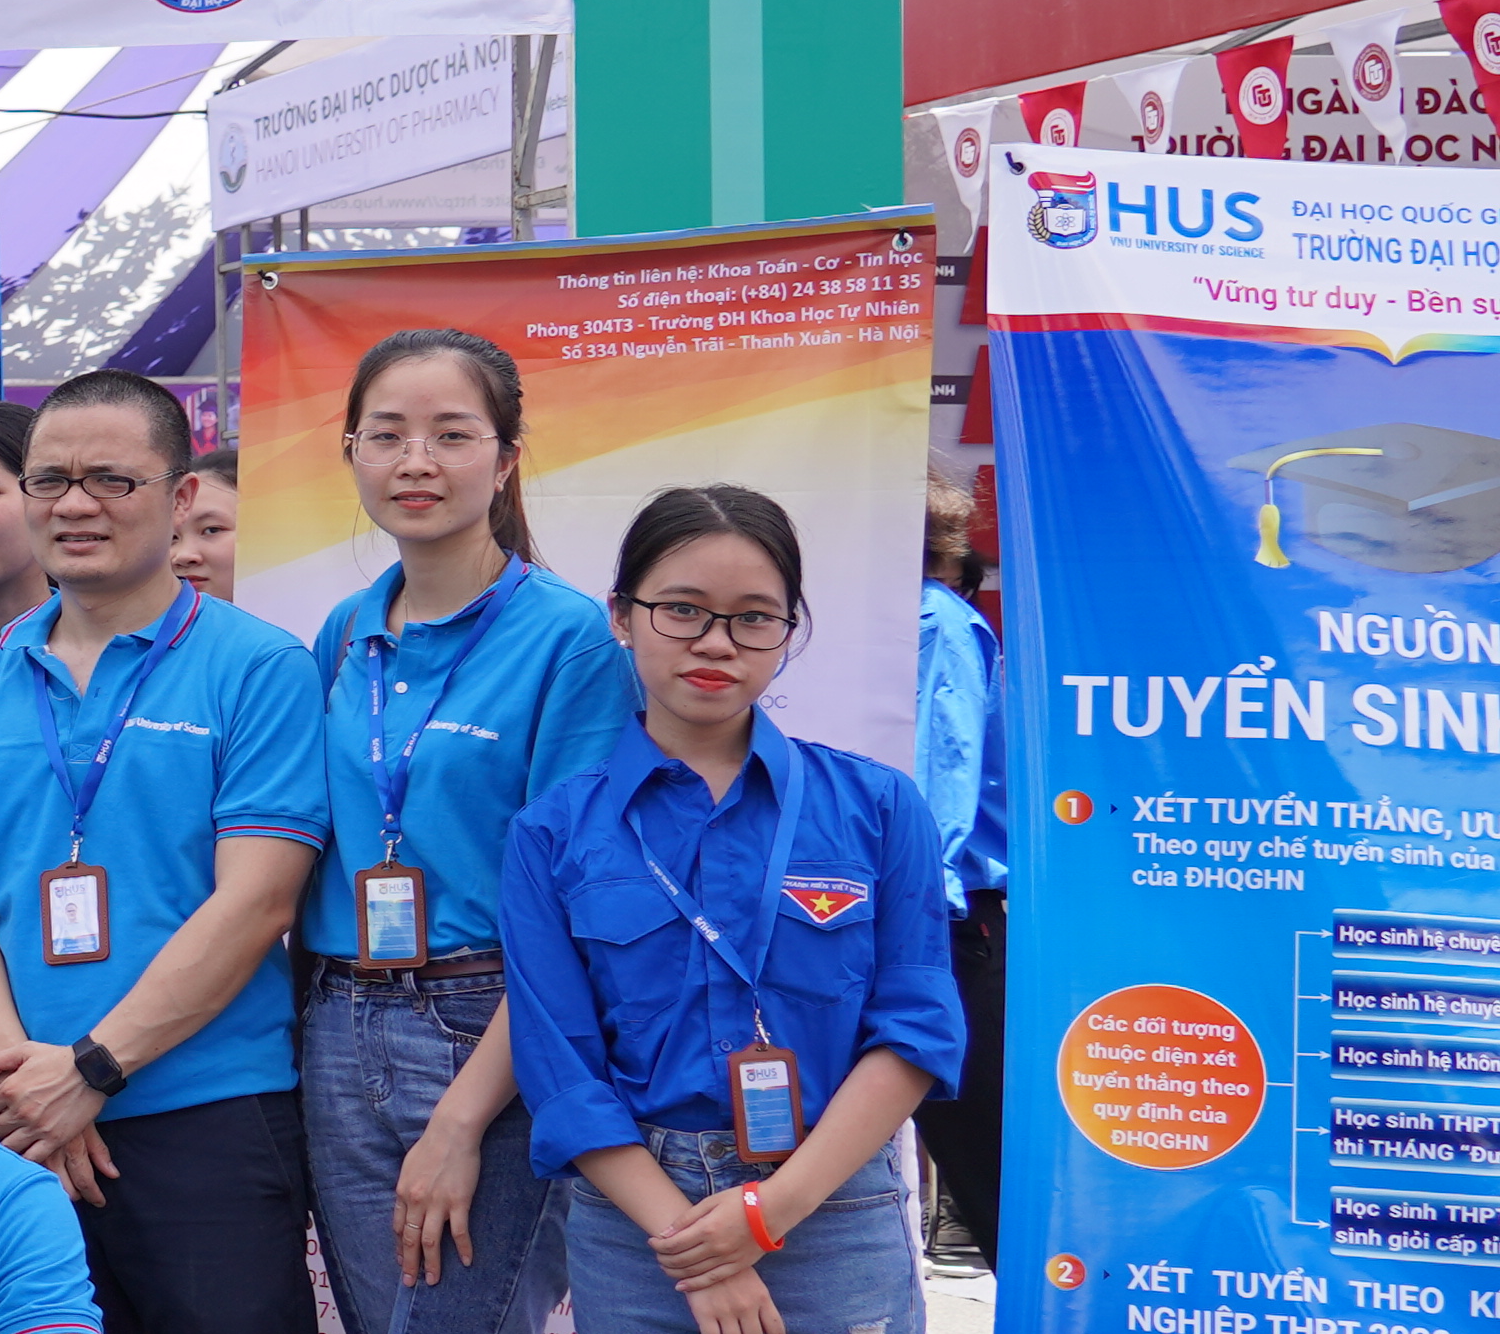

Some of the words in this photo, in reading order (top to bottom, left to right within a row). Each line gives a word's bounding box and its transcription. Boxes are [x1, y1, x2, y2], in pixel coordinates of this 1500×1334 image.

[254, 100, 317, 141] TRƯỜNG
[321, 93, 347, 122] ĐẠI
[352, 81, 385, 113] HỌC
[389, 64, 440, 97] DƯỢC
[444, 43, 470, 80] HÀ
[255, 147, 299, 184] HANOI
[302, 124, 384, 169] UNIVERSITY
[387, 114, 408, 144] OF
[411, 84, 501, 134] PHARMACY
[1107, 181, 1265, 241] HUS
[557, 274, 609, 290] Thông
[612, 271, 635, 286] tin
[640, 267, 668, 284] liên
[676, 266, 702, 284] hệ:
[707, 261, 751, 279] Khoa
[756, 258, 798, 276] Toán
[813, 255, 838, 272] Cơ
[856, 251, 883, 268] Tin
[888, 249, 923, 270] học
[617, 291, 640, 309] Số
[643, 291, 681, 309] điện
[685, 285, 736, 305] thoại:
[741, 283, 787, 304] (+84)
[792, 282, 815, 298] 24
[819, 279, 842, 297] 38
[845, 277, 867, 294] 58
[871, 275, 892, 292] 11
[898, 273, 921, 290] 35
[526, 322, 578, 340] Phòng
[583, 318, 633, 336] 304T3
[648, 312, 714, 333] Trường
[718, 309, 745, 326] ĐH
[750, 307, 795, 325] Khoa
[801, 305, 834, 324] Học
[838, 301, 861, 322] Tự
[866, 299, 920, 318] Nhiên
[562, 340, 582, 359] Số
[586, 341, 617, 359] 334
[623, 334, 687, 359] Nguyễn
[694, 336, 724, 352] Trãi
[739, 331, 794, 350] Thanh
[799, 328, 841, 346] Xuân
[859, 324, 883, 342] Hà
[889, 323, 920, 342] Nội
[1319, 605, 1500, 664] NGUỒN
[1063, 655, 1326, 741] TUYỂN
[1132, 832, 1197, 856] Theo
[1204, 840, 1251, 862] quy
[1258, 835, 1308, 859] chế
[1312, 838, 1383, 866] tuyển
[1390, 843, 1444, 867] sinh
[1450, 846, 1495, 871] của
[1132, 863, 1177, 886] của
[1185, 867, 1304, 892] ĐHQGHN
[1088, 1014, 1128, 1032] Các
[1133, 1016, 1166, 1034] đối
[1171, 1020, 1235, 1041] tượng
[1086, 1042, 1147, 1064] thuộc
[1151, 1046, 1197, 1065] diện
[1202, 1050, 1236, 1067] xét
[1072, 1070, 1130, 1091] tuyển
[1135, 1072, 1196, 1097] thẳng
[1201, 1080, 1250, 1097] theo
[1093, 1103, 1131, 1121] quy
[1137, 1102, 1182, 1122] định
[1189, 1105, 1227, 1123] của
[1110, 1130, 1209, 1151] ĐHQGHN
